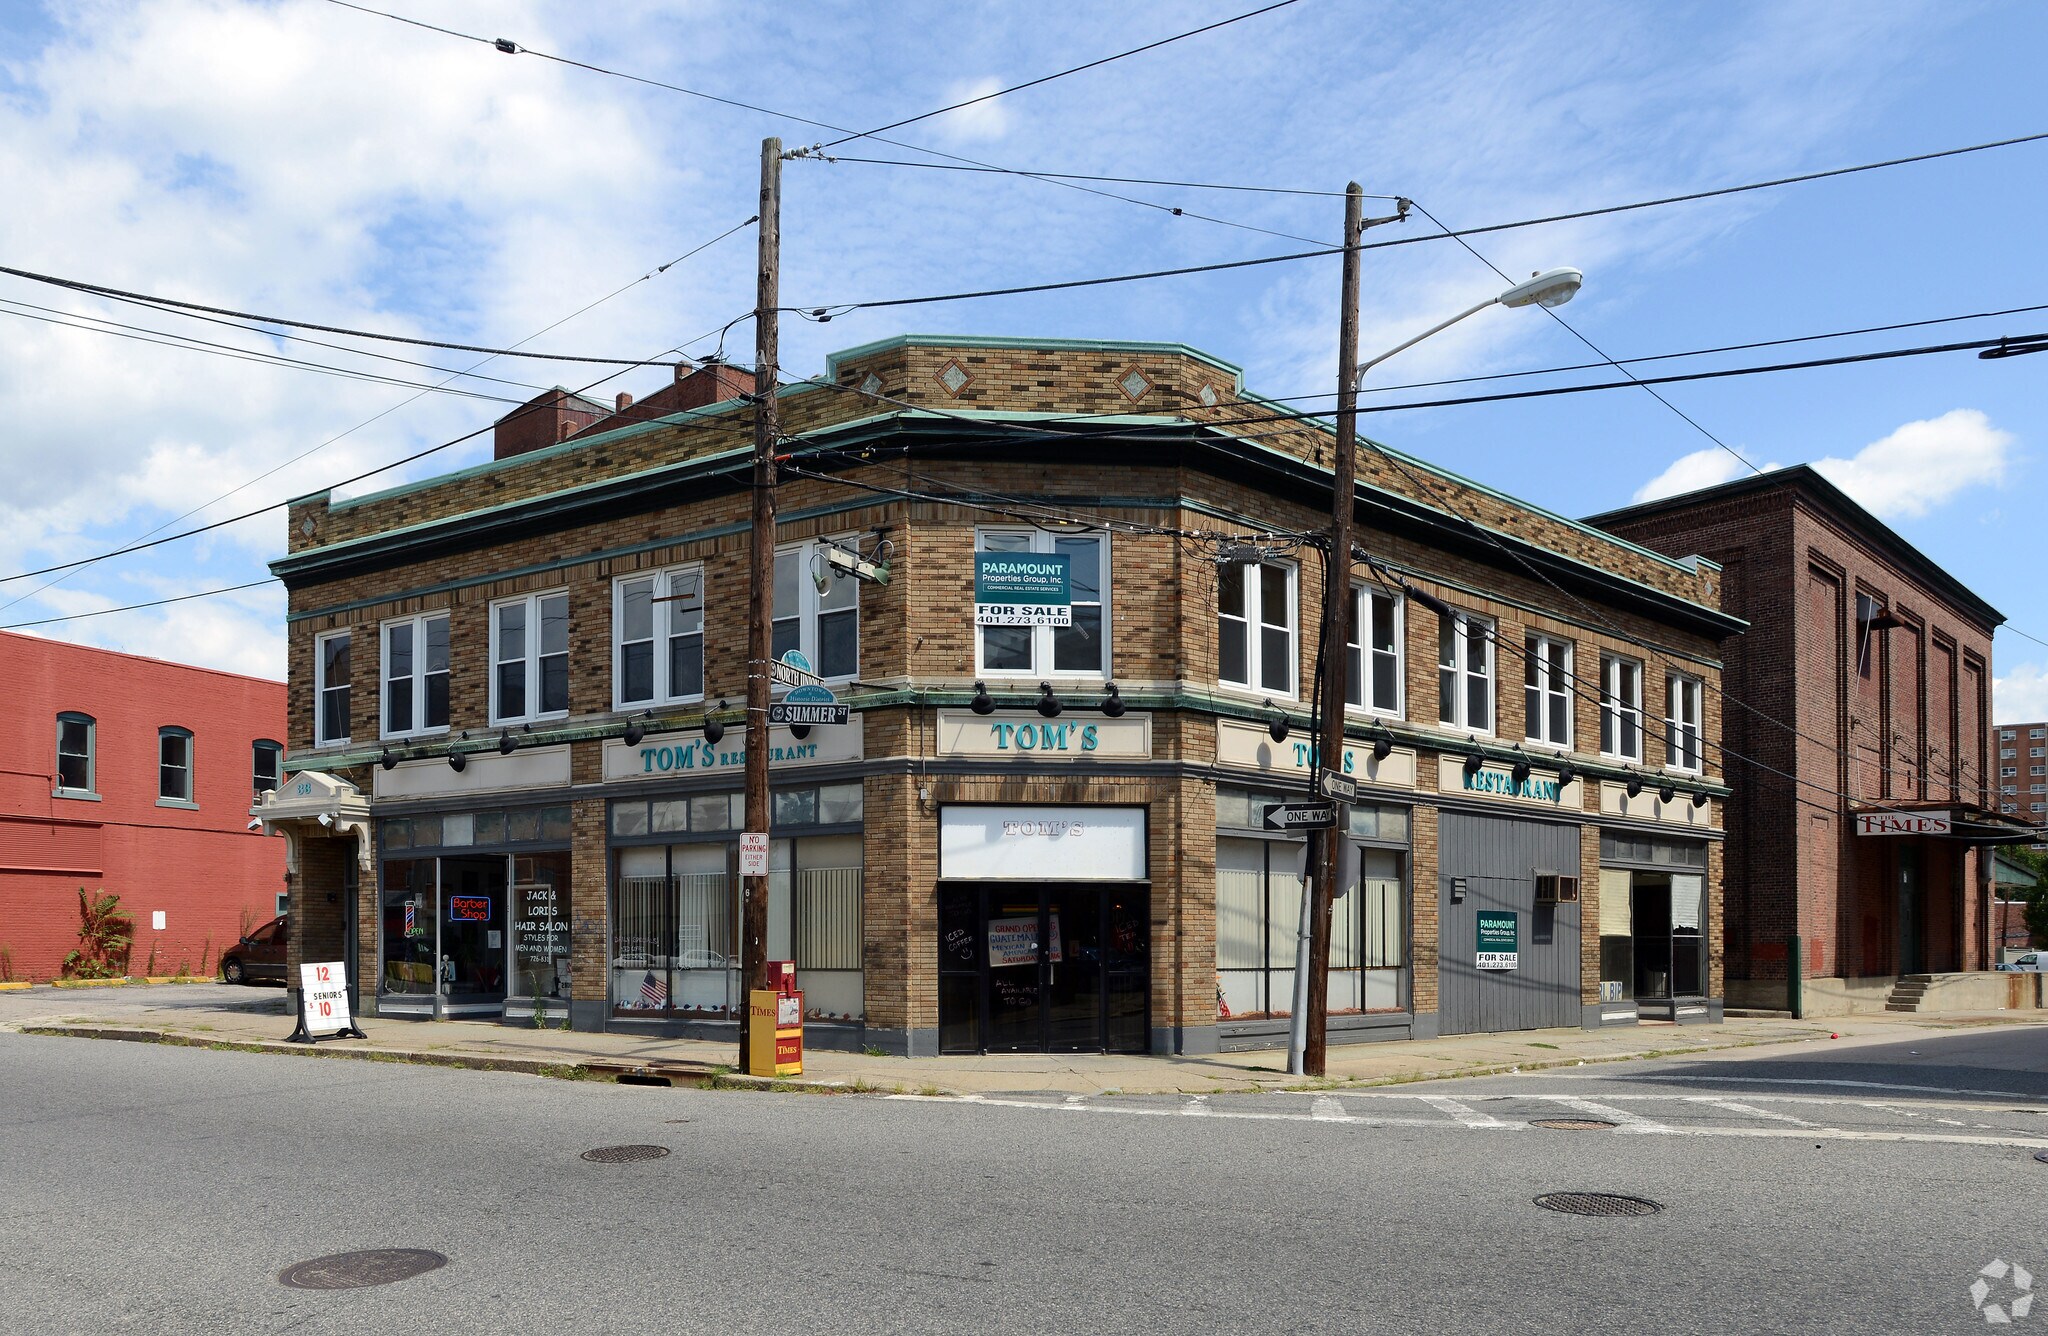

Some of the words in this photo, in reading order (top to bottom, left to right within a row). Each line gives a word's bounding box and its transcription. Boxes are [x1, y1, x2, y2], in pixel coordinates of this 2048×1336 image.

[982, 562, 1063, 575] PARAMOUNT
[982, 574, 1021, 583] Properties
[1023, 575, 1049, 584] Group,
[1050, 575, 1063, 584] Inc.
[978, 605, 1015, 615] FOR
[1021, 606, 1068, 617] SALE
[977, 615, 1069, 625] 401.273.6100
[776, 663, 800, 687] NORTH
[785, 706, 836, 723] SUMMER
[838, 707, 847, 716] ST
[991, 720, 1099, 751] TOM'S
[640, 738, 716, 772] TOM'S
[720, 743, 818, 766] RESURANT
[1293, 742, 1355, 774] TOS
[1331, 779, 1341, 791] ONE
[1342, 782, 1354, 795] WAY
[1286, 811, 1308, 822] ONE
[1312, 810, 1331, 821] WAY
[1003, 821, 1084, 836] TOM'S
[1861, 815, 1947, 833] TIMES
[749, 836, 760, 844] NO
[742, 844, 766, 853] PARKING
[526, 891, 548, 901] JACK
[550, 890, 557, 901] &
[453, 898, 488, 908] Barber
[461, 909, 487, 920] Shop
[528, 906, 558, 916] LORIS
[514, 921, 536, 931] HAIR
[539, 921, 568, 931] SALON
[995, 925, 1021, 934] GRAND
[1480, 920, 1515, 929] PARAMOUNT
[523, 933, 545, 942] STYLES
[546, 934, 559, 942] FOR
[944, 929, 965, 942] ICED
[514, 944, 528, 952] MEN
[529, 944, 543, 953] AND
[543, 945, 567, 954] WOMEN
[948, 935, 973, 952] COFFEE
[316, 966, 330, 981] 12
[313, 991, 343, 1000] SENIORS
[1003, 997, 1015, 1005] TO
[1020, 997, 1032, 1006] GO
[319, 1001, 331, 1016] 10
[750, 1005, 776, 1017] TIMES
[777, 1045, 797, 1055] TIMES
